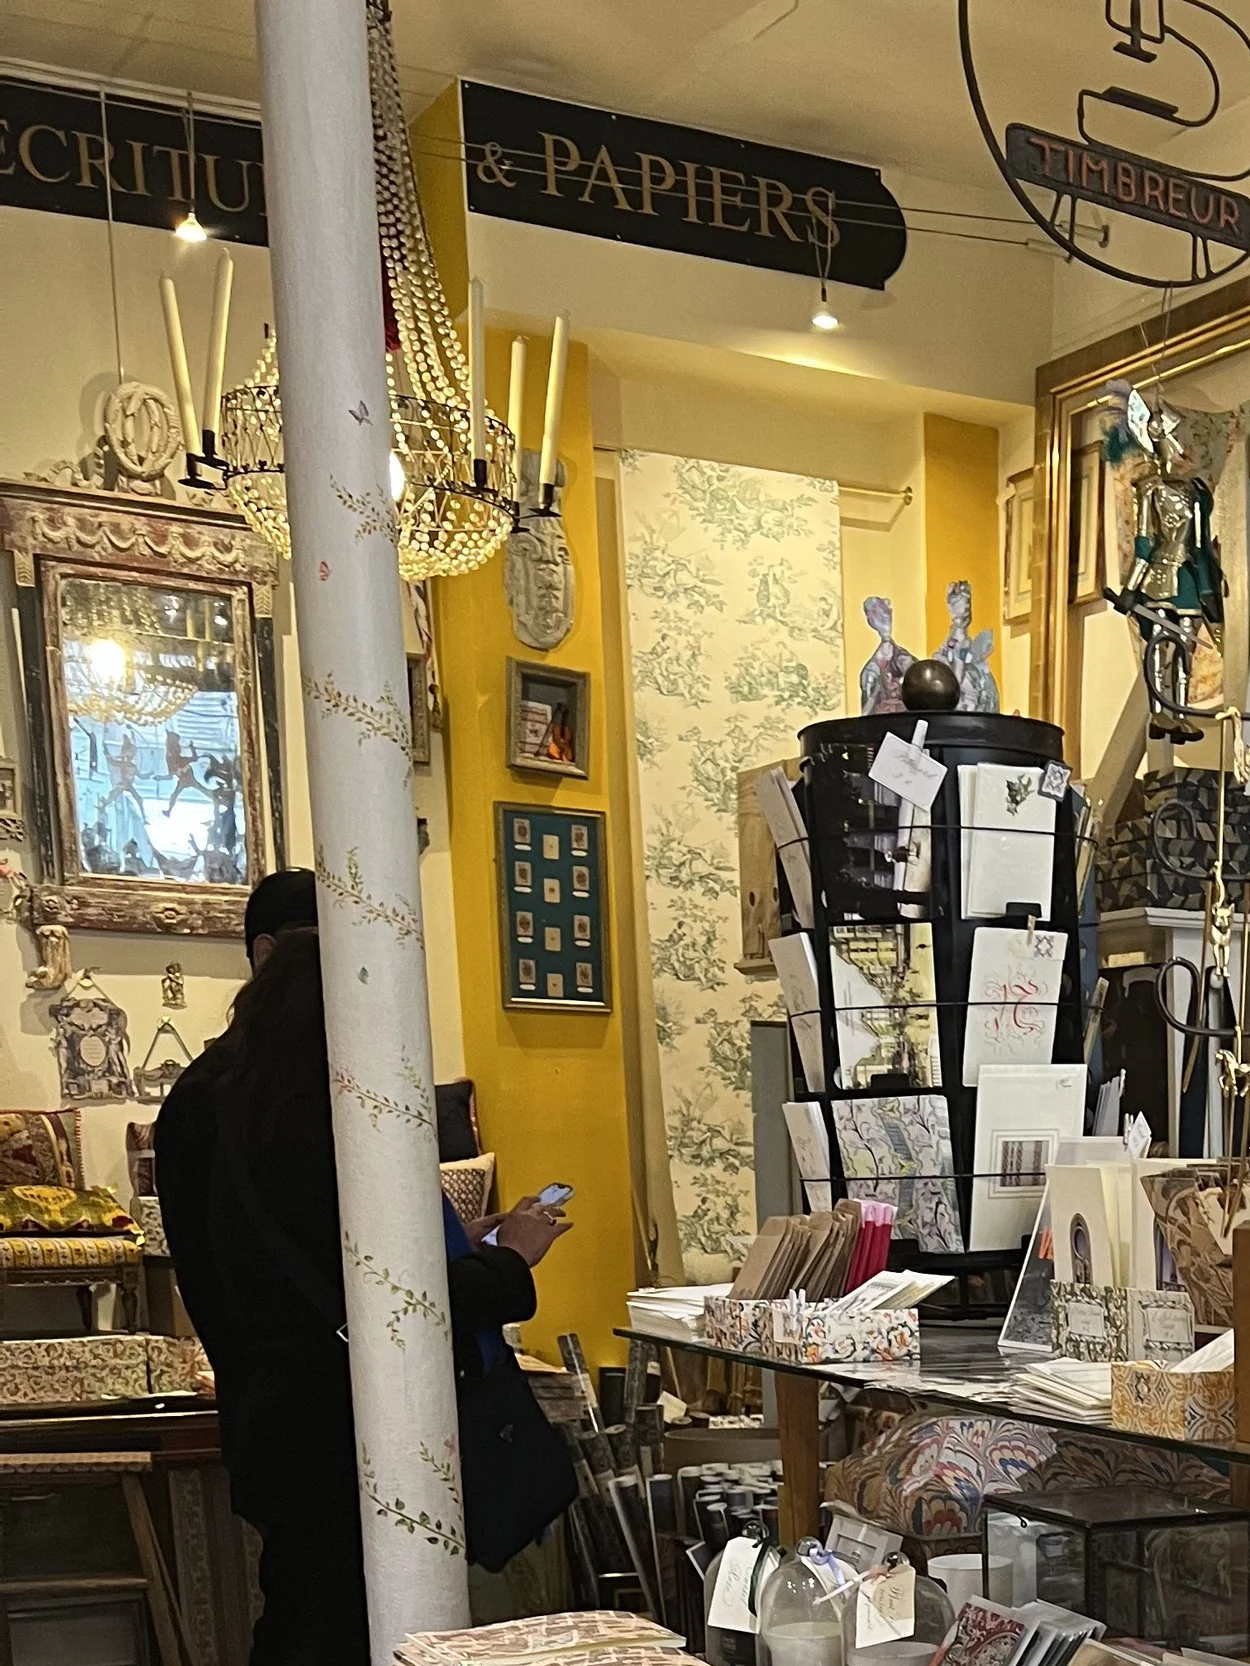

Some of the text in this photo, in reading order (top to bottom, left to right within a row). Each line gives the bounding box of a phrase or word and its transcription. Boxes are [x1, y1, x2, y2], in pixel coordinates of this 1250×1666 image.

[477, 131, 841, 249] & PAPIERS
[1029, 137, 1240, 237] TIMBREUR
